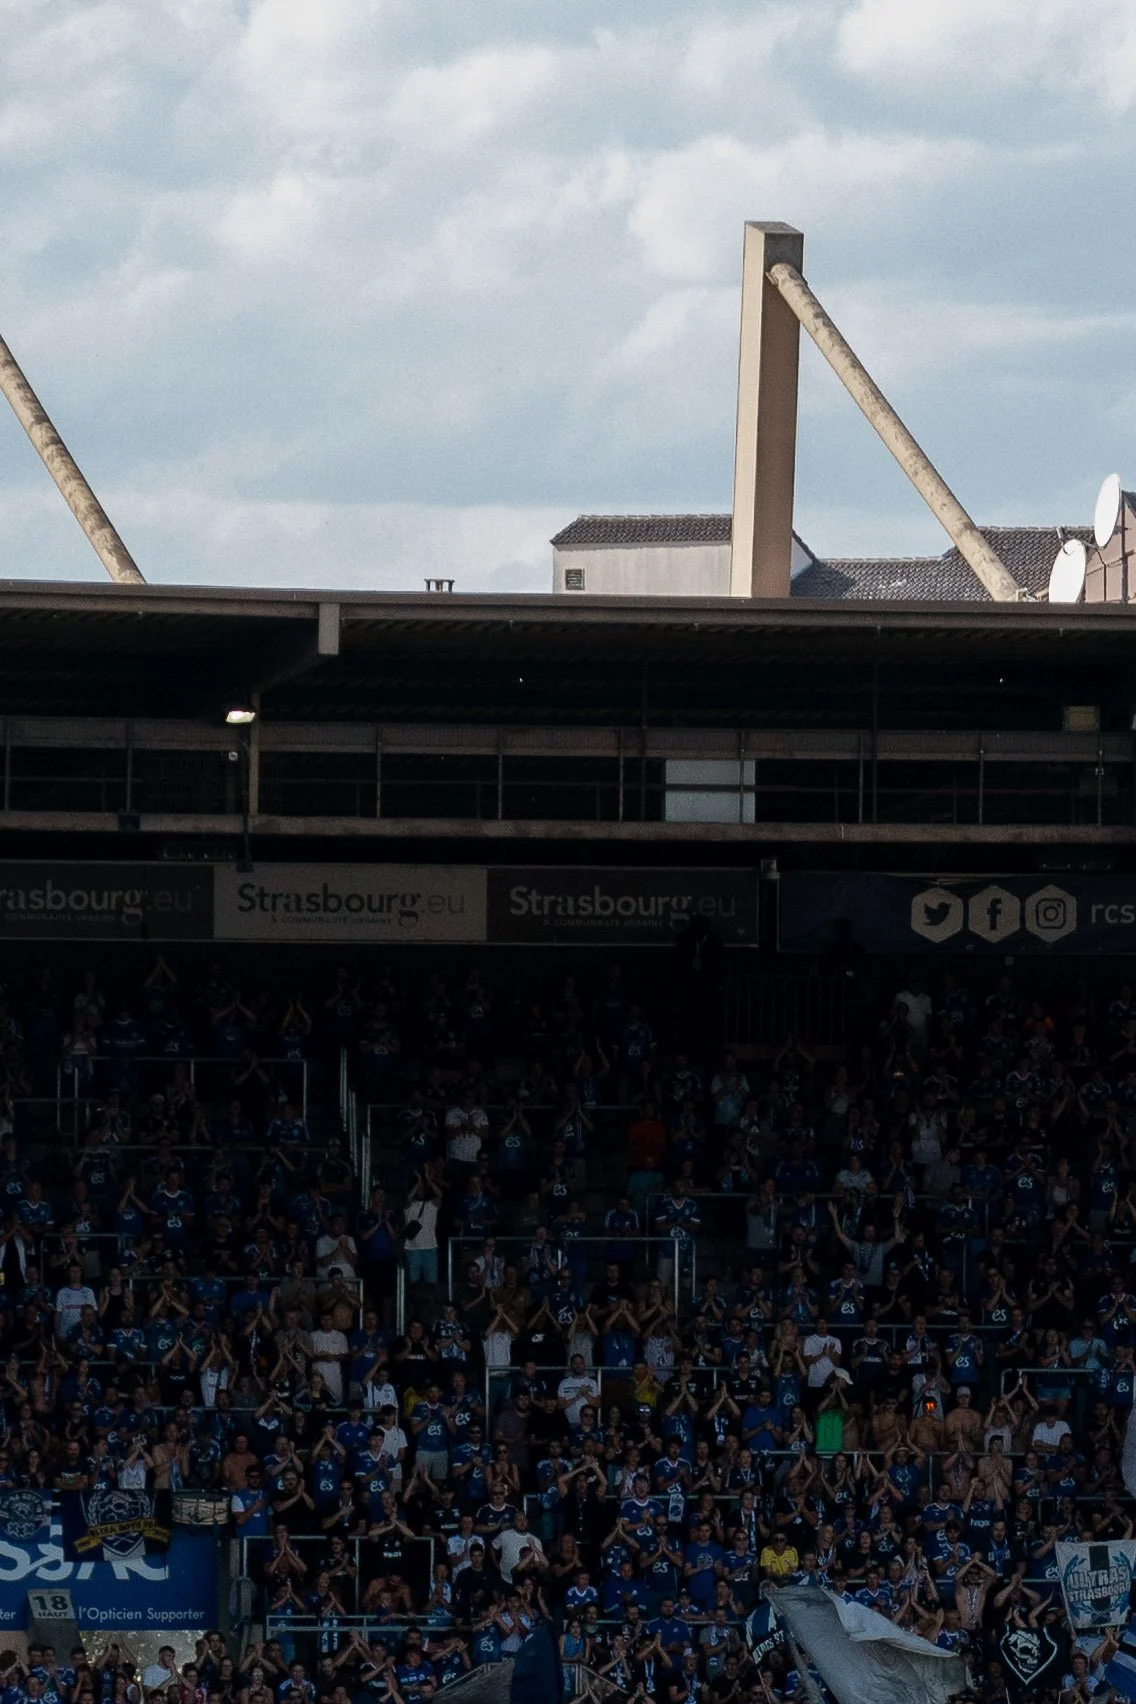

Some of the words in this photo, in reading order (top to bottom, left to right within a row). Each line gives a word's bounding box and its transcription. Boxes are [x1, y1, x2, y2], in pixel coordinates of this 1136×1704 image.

[237, 882, 466, 929] Strasbourg.eu
[508, 885, 736, 930] Strasbourg.eu
[33, 1595, 69, 1611] 18
[78, 1607, 142, 1624] l'Opticien
[146, 1607, 206, 1625] Supporter
